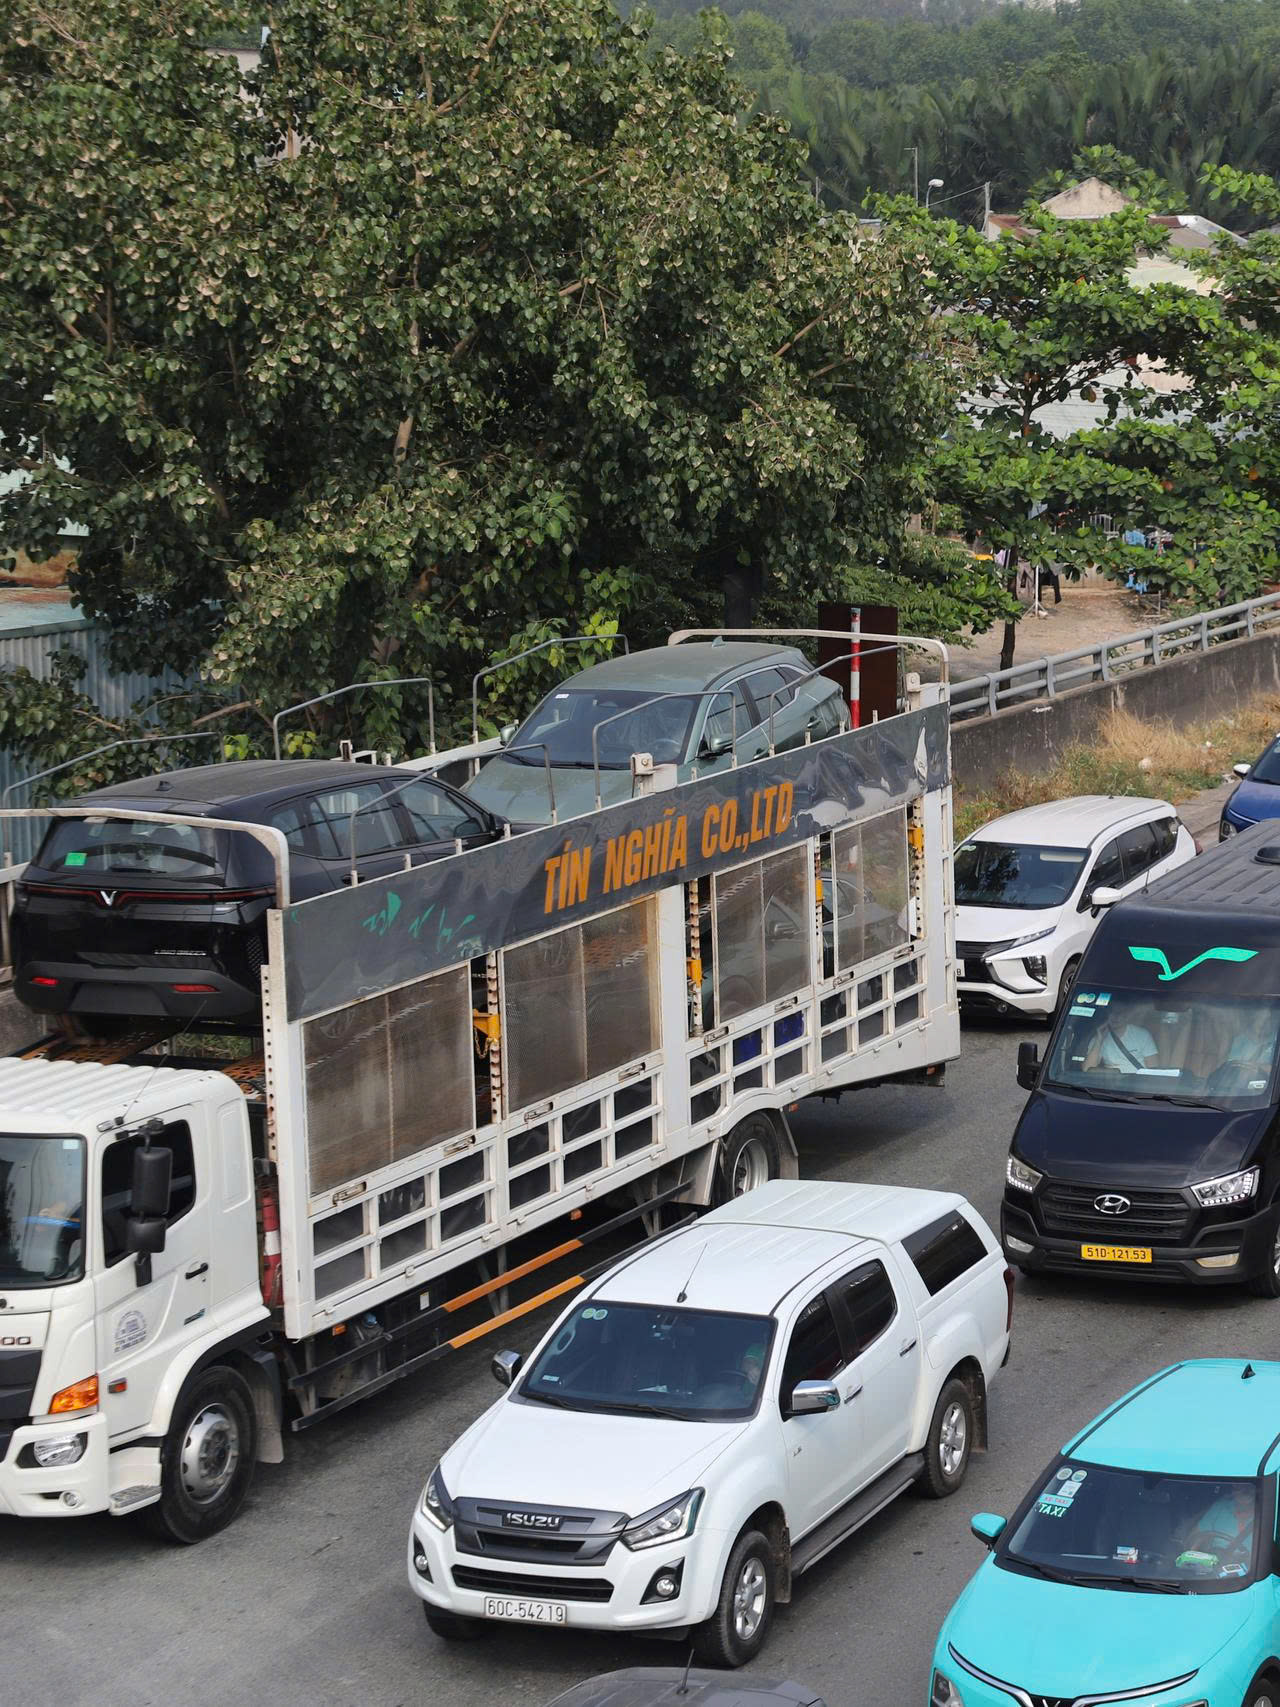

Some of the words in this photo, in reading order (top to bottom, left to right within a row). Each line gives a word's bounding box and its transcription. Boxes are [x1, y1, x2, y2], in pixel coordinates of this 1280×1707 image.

[543, 840, 592, 914] TÍN
[603, 807, 688, 894] NGHĨA
[701, 780, 794, 859] CO.,LTD
[1087, 1247, 1147, 1260] 51D-121.53
[1038, 1503, 1068, 1518] TAXI
[506, 1512, 561, 1528] ISUZU
[487, 1599, 565, 1622] 60C-542.19
